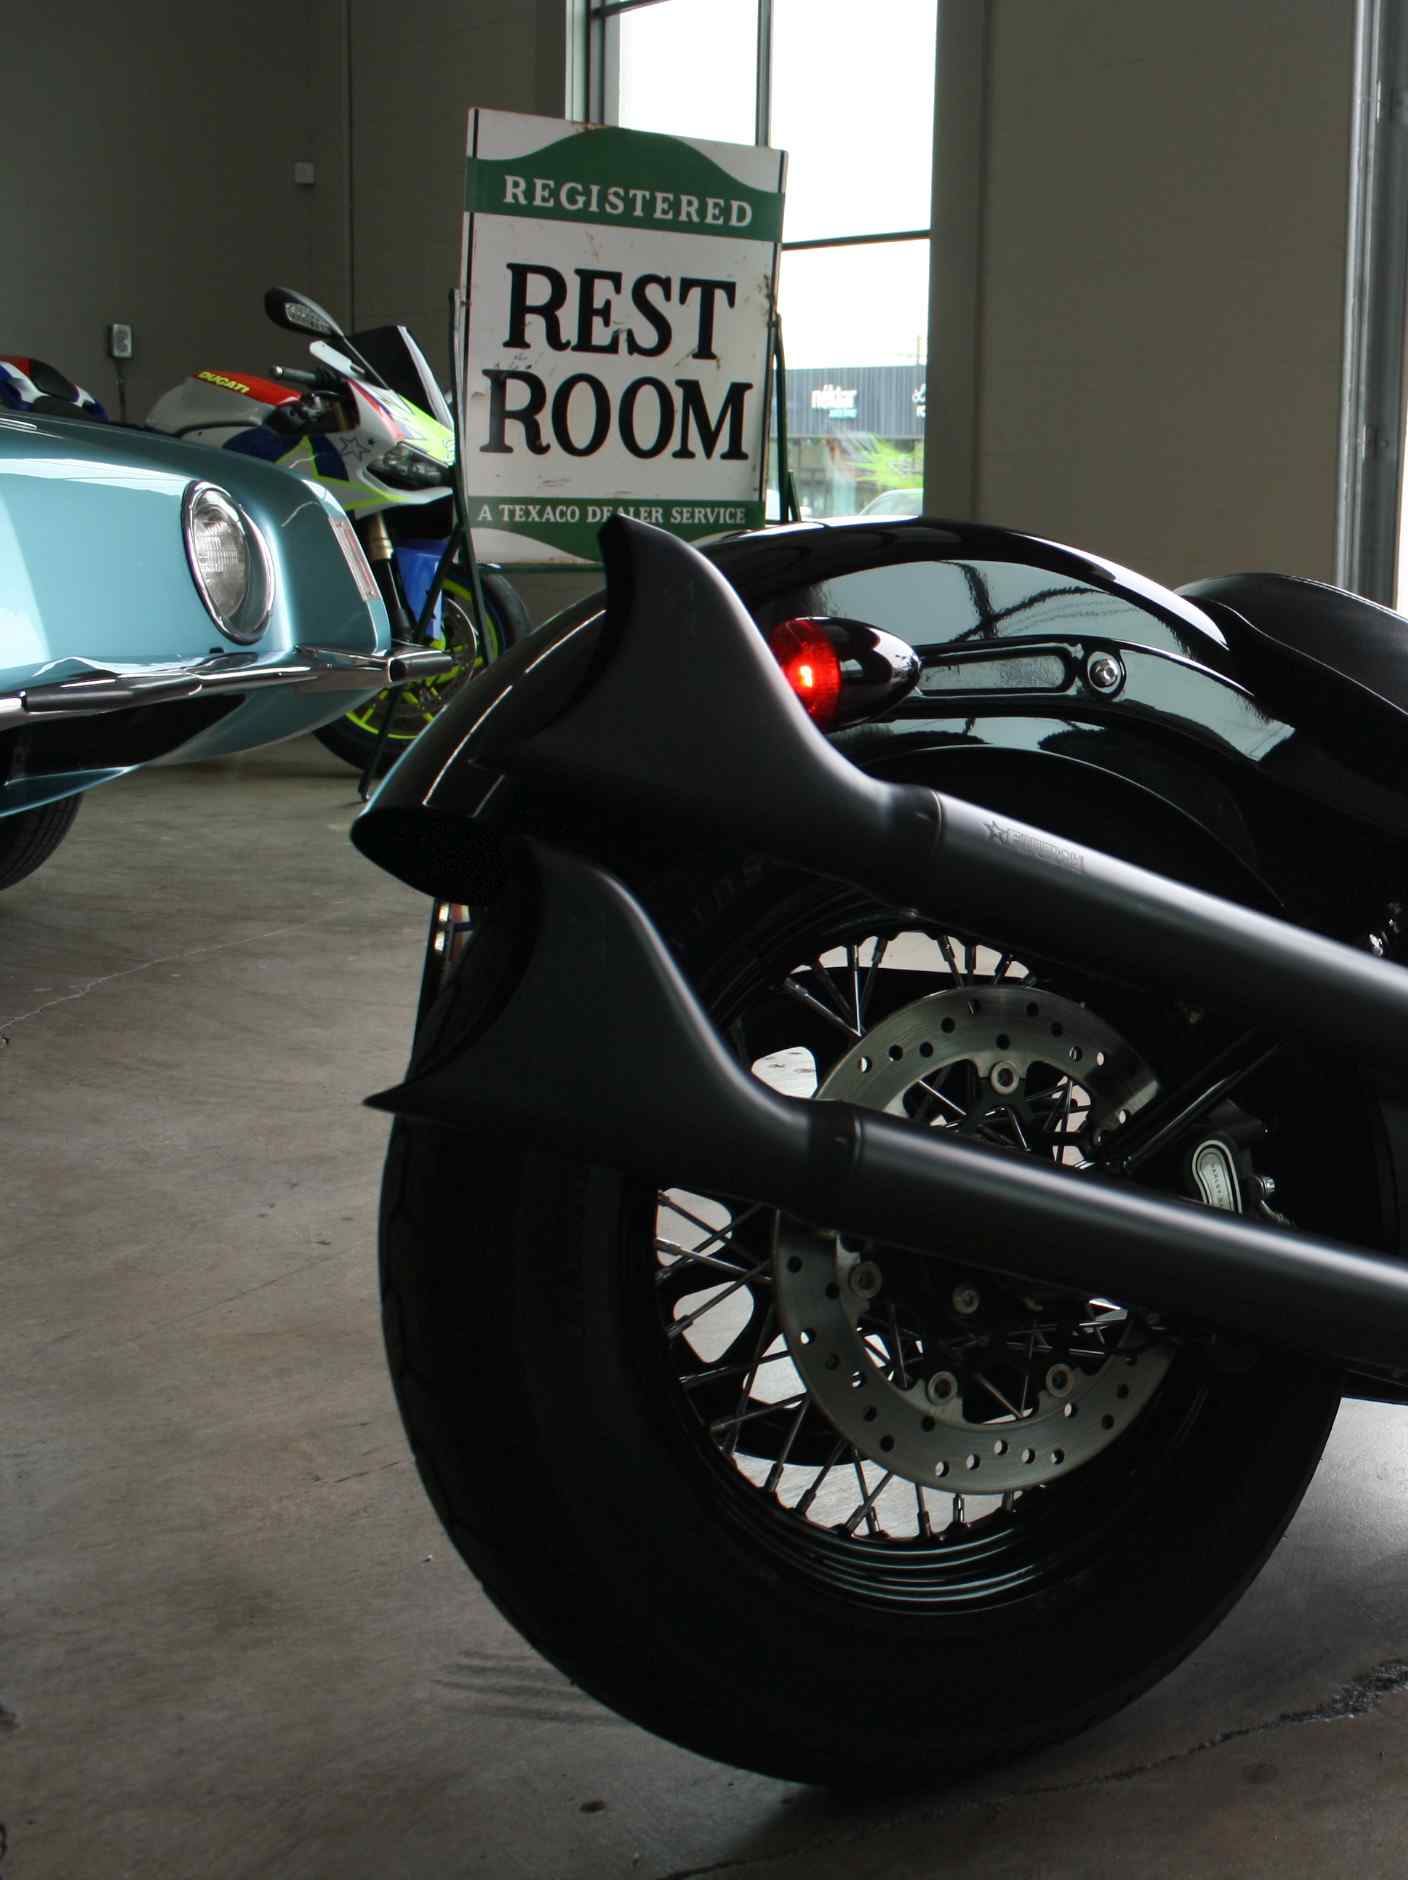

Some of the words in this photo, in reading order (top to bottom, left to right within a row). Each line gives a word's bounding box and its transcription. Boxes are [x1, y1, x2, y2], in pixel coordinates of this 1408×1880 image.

[503, 175, 752, 228] REGISTERED
[502, 262, 737, 360] REST
[197, 371, 250, 393] DUCATI
[480, 368, 753, 460] ROOM
[477, 504, 493, 522] A
[499, 504, 580, 523] TEXACO
[670, 507, 746, 524] SERVICE
